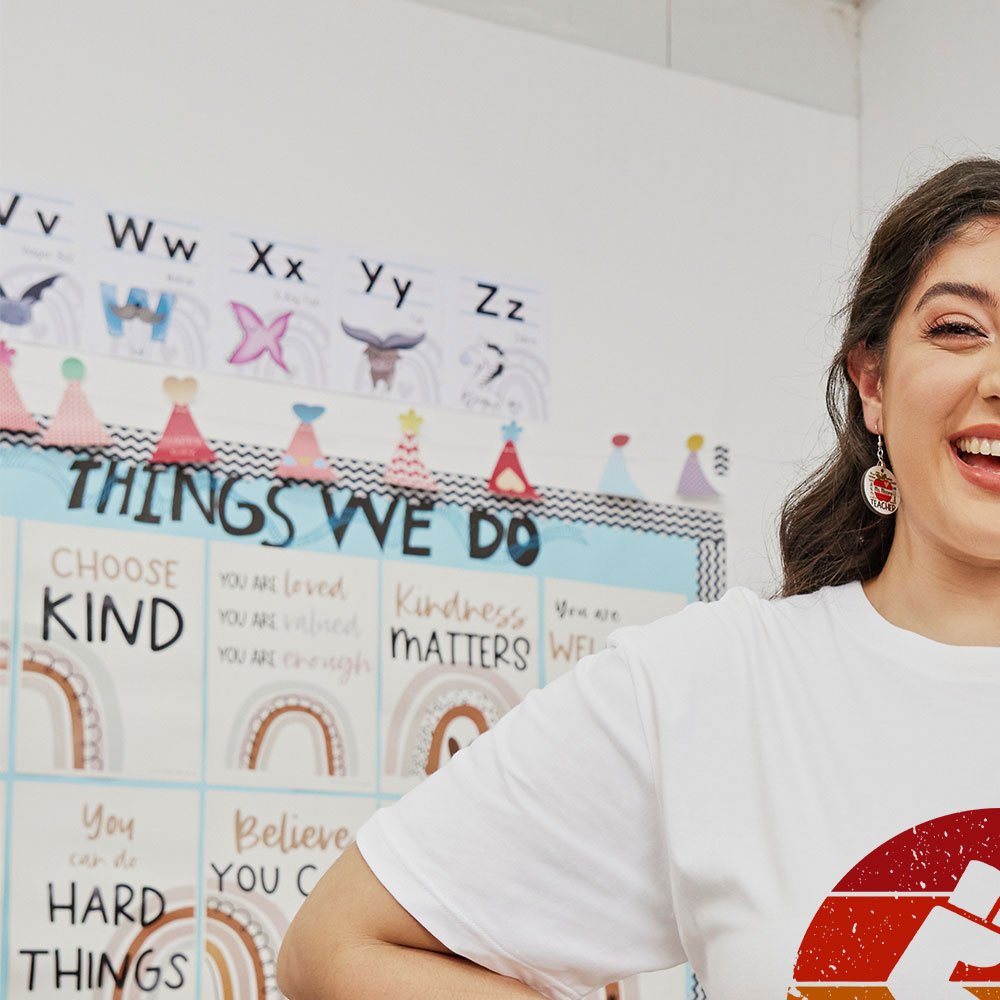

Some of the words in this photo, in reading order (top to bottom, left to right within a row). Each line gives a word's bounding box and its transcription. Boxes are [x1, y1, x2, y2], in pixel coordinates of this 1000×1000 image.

[67, 459, 295, 547] THINGS
[320, 488, 431, 556] WE
[469, 510, 541, 567] DO
[51, 547, 179, 589] CHOOSE
[218, 571, 247, 592] YOU
[252, 575, 277, 593] ARE
[283, 569, 349, 600] loved
[43, 586, 185, 652] KIND
[218, 608, 247, 629] YOU
[251, 611, 276, 631] ARE
[394, 582, 527, 631] Kindness
[554, 599, 588, 619] You
[217, 645, 246, 666] YOU
[250, 648, 275, 668] ARE
[283, 649, 373, 685] enough
[390, 626, 531, 671] MATTERS
[82, 802, 135, 840] You
[233, 808, 353, 854] Believe
[69, 851, 105, 868] can
[113, 849, 138, 869] do
[210, 862, 280, 895] YOU
[48, 882, 166, 927] HARD
[18, 947, 189, 992] THINGS
